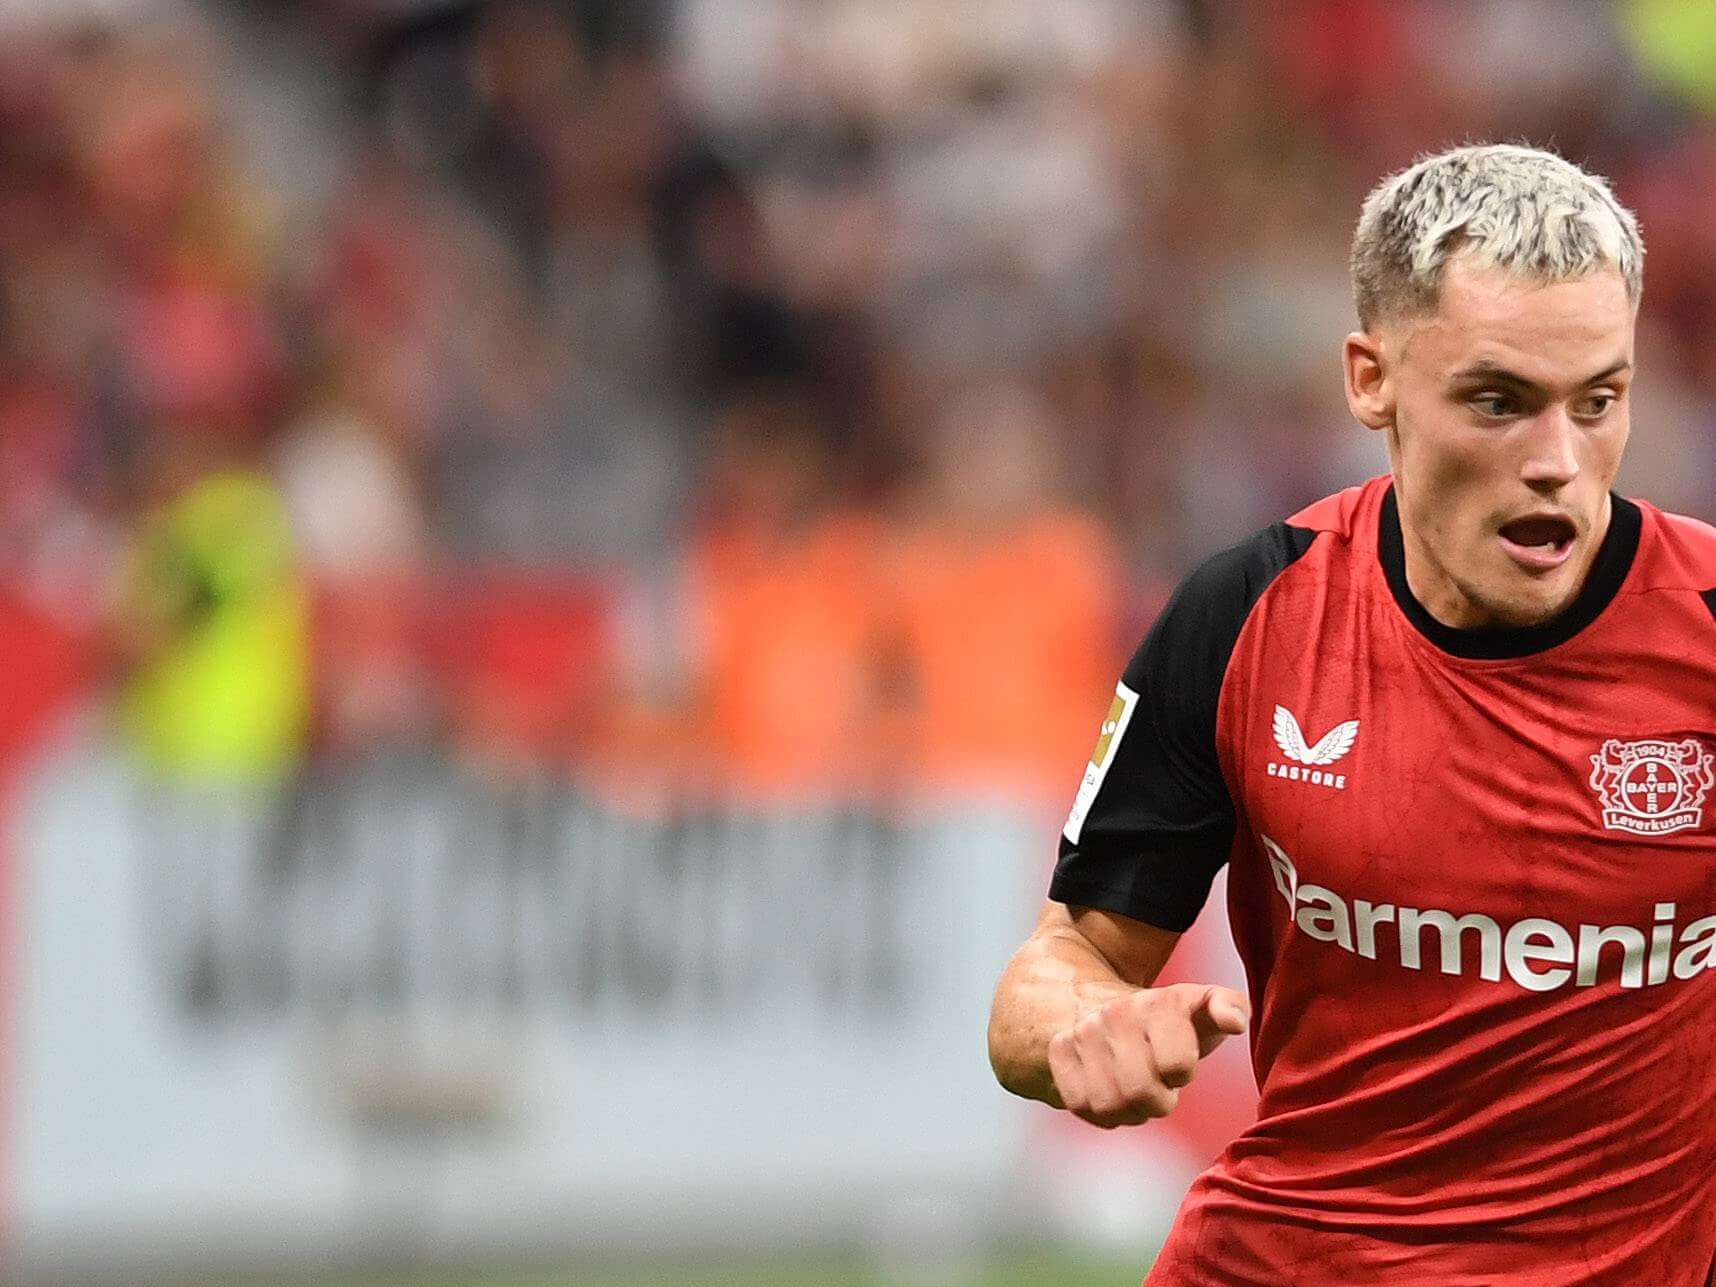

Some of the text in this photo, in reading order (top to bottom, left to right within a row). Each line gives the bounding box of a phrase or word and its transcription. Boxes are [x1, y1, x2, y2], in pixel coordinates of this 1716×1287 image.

[1636, 745, 1666, 757] 1904
[1267, 762, 1346, 789] CASTORE
[1627, 783, 1677, 793] BAYER
[1611, 813, 1693, 830] Leverkusen
